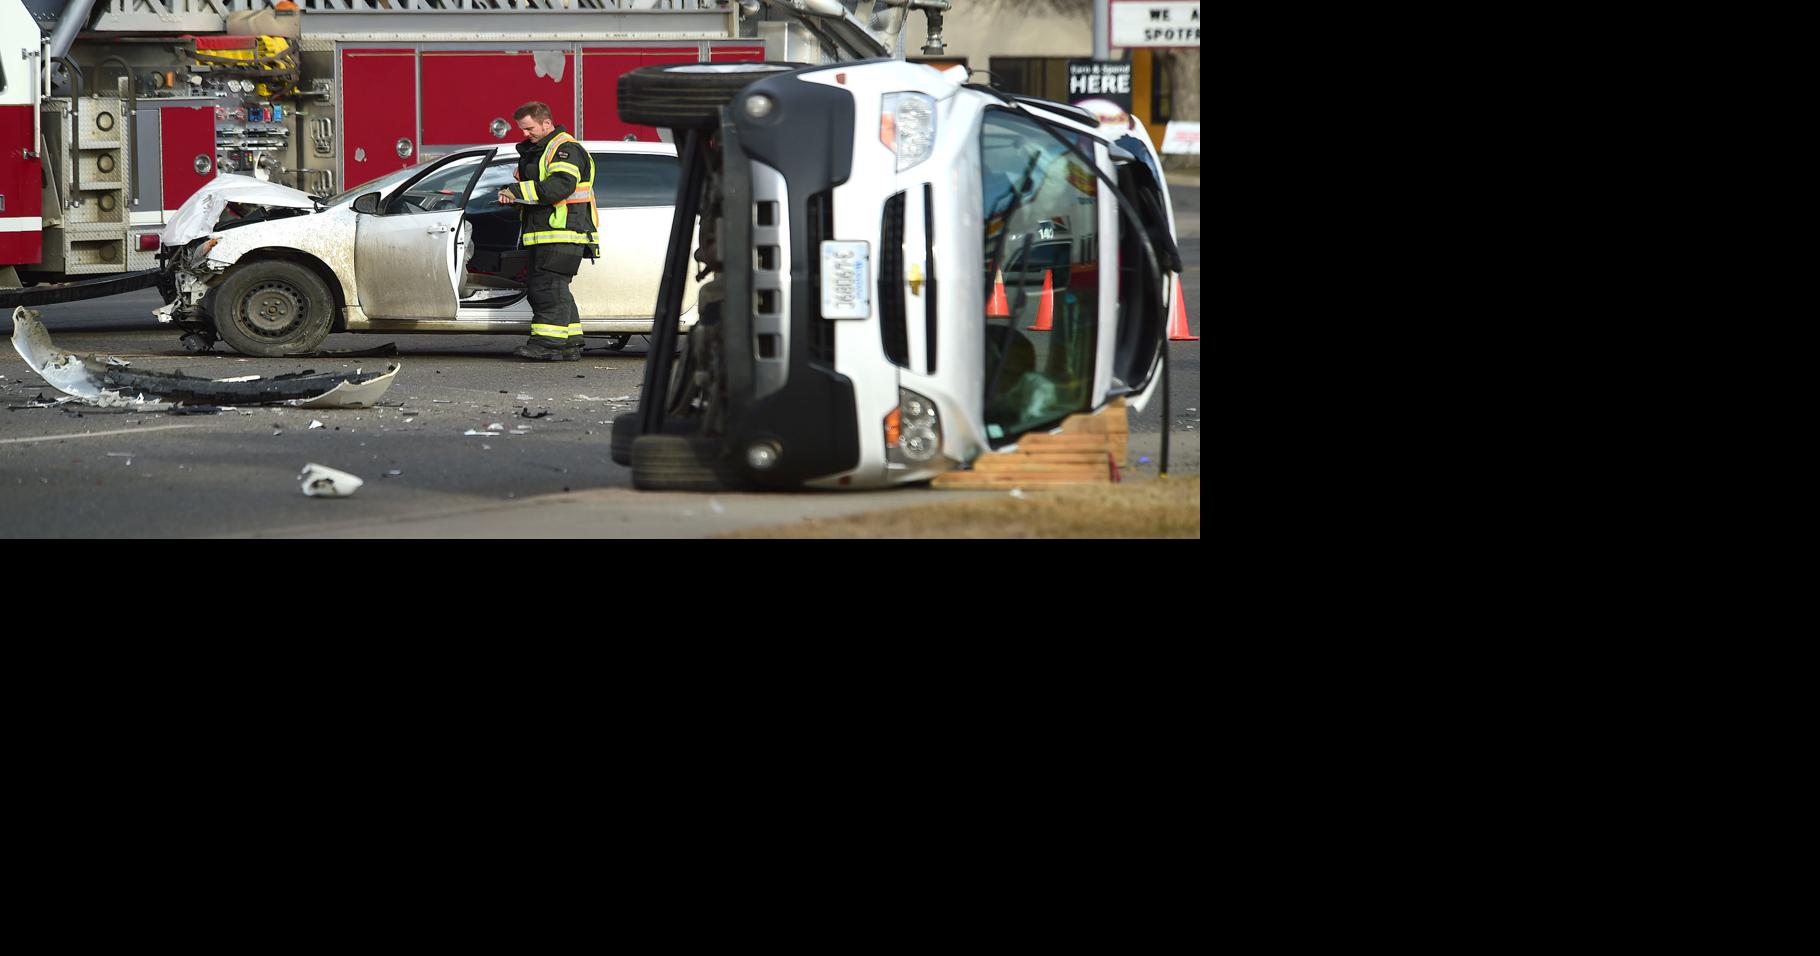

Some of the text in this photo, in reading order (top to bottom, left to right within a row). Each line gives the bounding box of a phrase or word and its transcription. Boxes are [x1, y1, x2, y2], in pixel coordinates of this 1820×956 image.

[1150, 8, 1169, 20] WE
[1092, 64, 1100, 74] &
[1070, 74, 1130, 94] HERE
